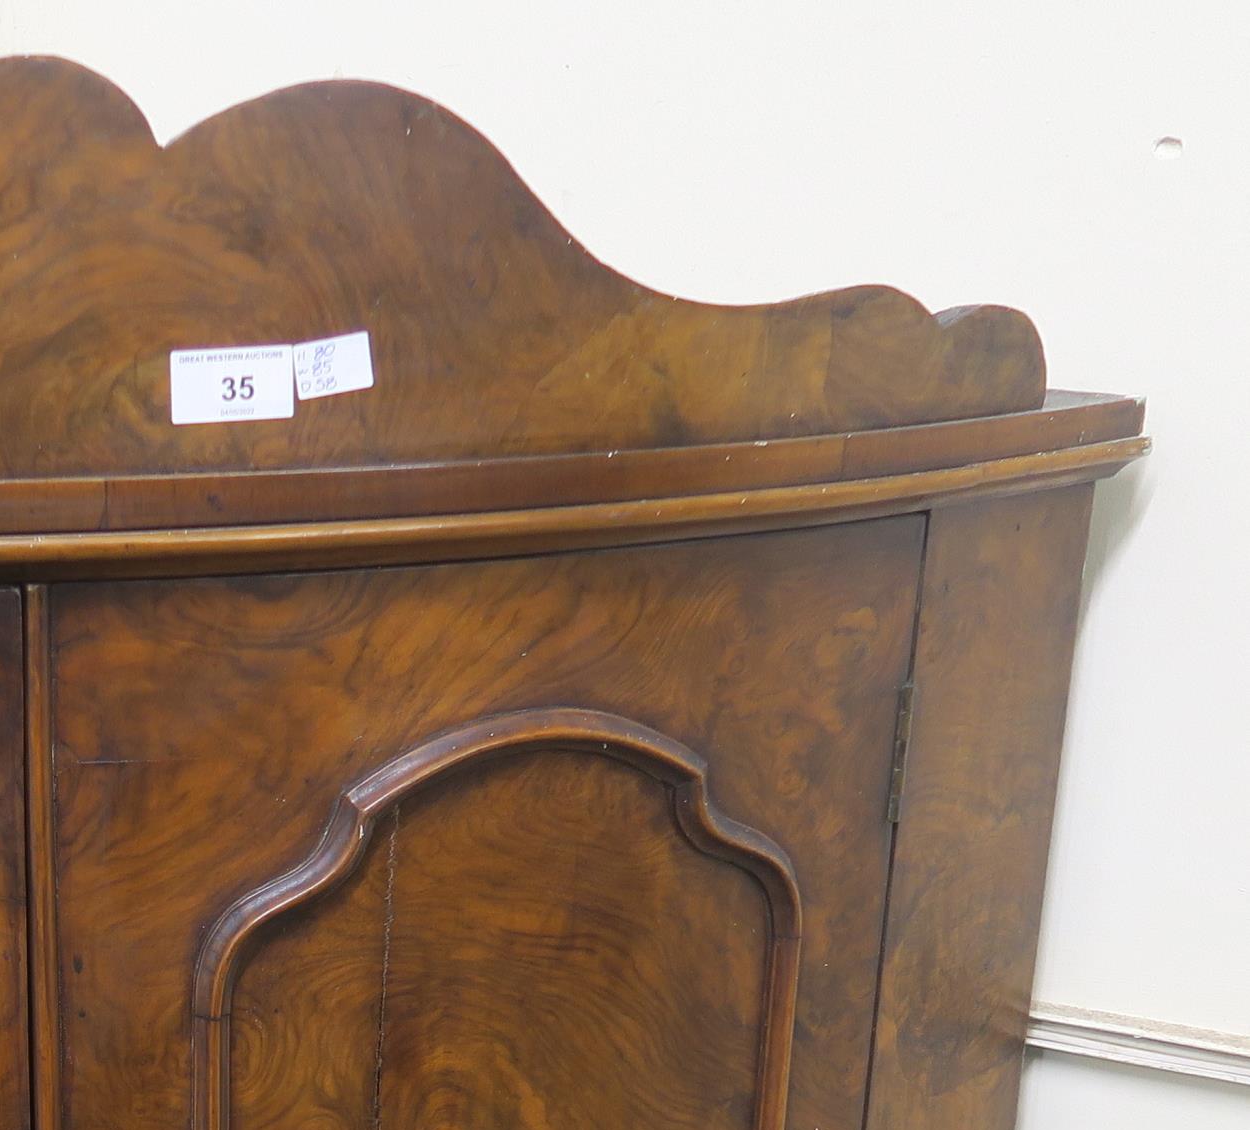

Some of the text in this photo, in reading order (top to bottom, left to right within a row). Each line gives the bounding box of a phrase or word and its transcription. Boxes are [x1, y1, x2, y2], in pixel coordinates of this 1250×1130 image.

[179, 350, 283, 364] GREAT WESTERN AUCTIONS
[221, 375, 255, 402] 35
